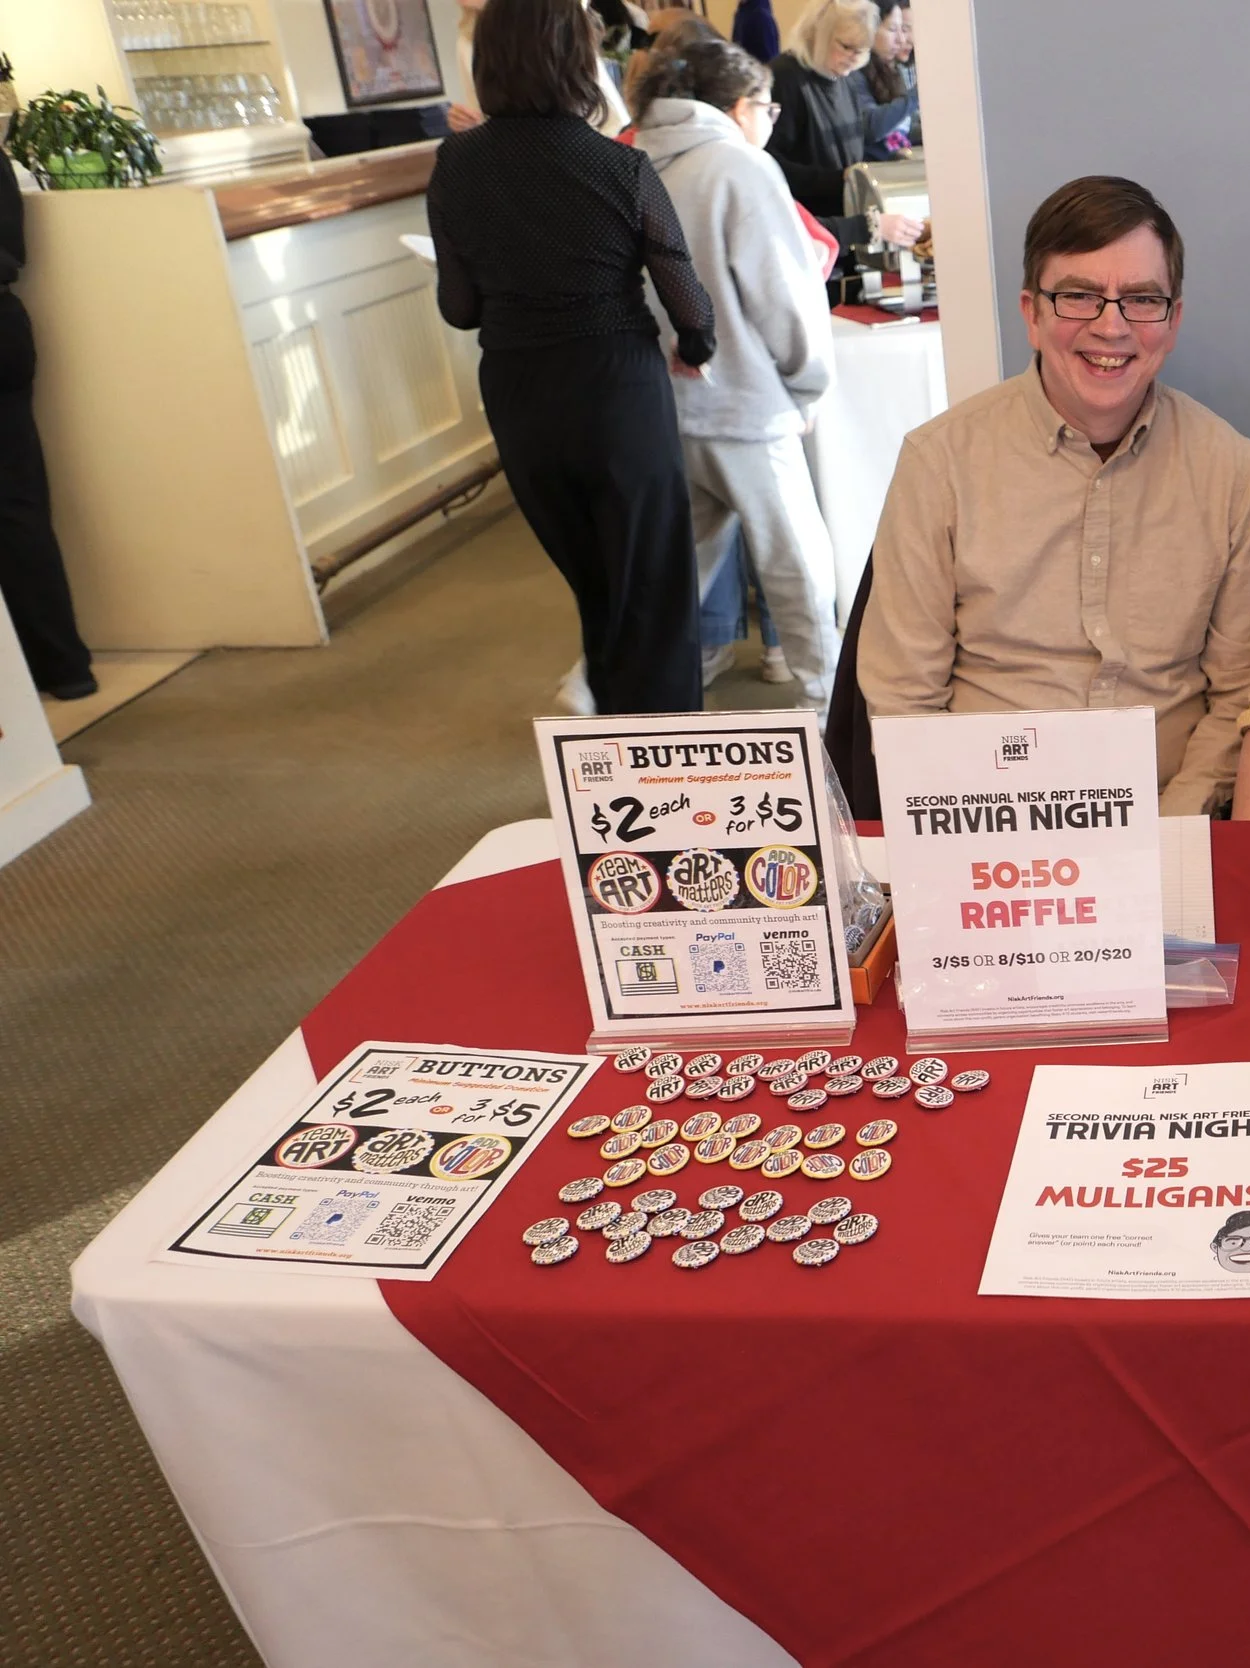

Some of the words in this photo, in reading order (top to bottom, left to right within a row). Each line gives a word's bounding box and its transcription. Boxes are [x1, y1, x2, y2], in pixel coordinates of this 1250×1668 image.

[1001, 736, 1027, 744] NISK
[579, 752, 610, 762] NISK
[627, 741, 794, 769] BUTTONS
[1002, 744, 1029, 755] ART
[581, 761, 613, 775] ART
[638, 775, 684, 785] Minimum
[686, 773, 741, 784] Suggested
[744, 771, 792, 781] Donation
[649, 793, 691, 820] each
[729, 795, 746, 816] 3
[906, 795, 958, 807] SECOND
[962, 793, 1015, 805] ANNUAL
[1017, 791, 1046, 803] NISK
[1050, 790, 1076, 801] ART
[1079, 788, 1133, 800] FRIENDS
[591, 796, 656, 844] $2
[696, 813, 713, 823] OR
[755, 792, 803, 833] $5
[907, 805, 1017, 835] TRIVIA
[1029, 800, 1134, 830] NIGHT
[725, 818, 756, 836] for
[768, 850, 796, 865] ADD
[751, 857, 811, 901] COLOR
[971, 858, 1080, 890] 50:50
[599, 871, 653, 908] ART
[601, 920, 642, 930] Boosting
[643, 919, 688, 929] creativity
[690, 918, 708, 927] and
[709, 916, 761, 926] community
[763, 914, 801, 924] through
[802, 912, 819, 922] art!
[960, 896, 1098, 930] RAFFLE
[696, 932, 735, 942] PayPal
[763, 930, 810, 940] venmo
[620, 945, 666, 957] CASH
[932, 955, 970, 970] 3/$5
[973, 954, 996, 968] OR
[998, 951, 1045, 967] 8/$10
[1049, 951, 1072, 964] OR
[1074, 947, 1133, 963] 20/$20
[618, 1049, 648, 1069] ART
[649, 1057, 680, 1076] ART
[688, 1058, 718, 1076] ART
[865, 1058, 895, 1076] ART
[367, 1065, 399, 1076] ART
[413, 1058, 568, 1084] BUTTONS
[408, 1077, 452, 1087] Minimum
[452, 1081, 502, 1091] Suggested
[504, 1084, 551, 1093] Donation
[650, 1080, 682, 1098] ART
[1151, 1083, 1179, 1091] ART
[332, 1088, 397, 1119] $2
[393, 1092, 443, 1107] each
[468, 1098, 489, 1110] 3
[434, 1105, 451, 1114] OR
[450, 1111, 486, 1125] for
[488, 1099, 541, 1127] $5
[1047, 1113, 1100, 1122] SECOND
[1104, 1112, 1155, 1122] ANNUAL
[1159, 1112, 1189, 1121] NISK
[1192, 1111, 1219, 1120] ART
[1046, 1121, 1156, 1140] TRIVIA
[283, 1139, 350, 1163] ART
[473, 1137, 500, 1148] ADD
[439, 1141, 505, 1174] COLOR
[1121, 1157, 1189, 1178] $25
[256, 1171, 298, 1182] Boosting
[298, 1175, 343, 1185] creativity
[344, 1177, 365, 1185] and
[364, 1179, 419, 1190] community
[420, 1182, 457, 1192] through
[460, 1185, 480, 1193] art!
[249, 1192, 300, 1205] CASH
[335, 1189, 380, 1199] PayPal
[406, 1194, 457, 1206] venmo
[1073, 1240, 1096, 1248] point)
